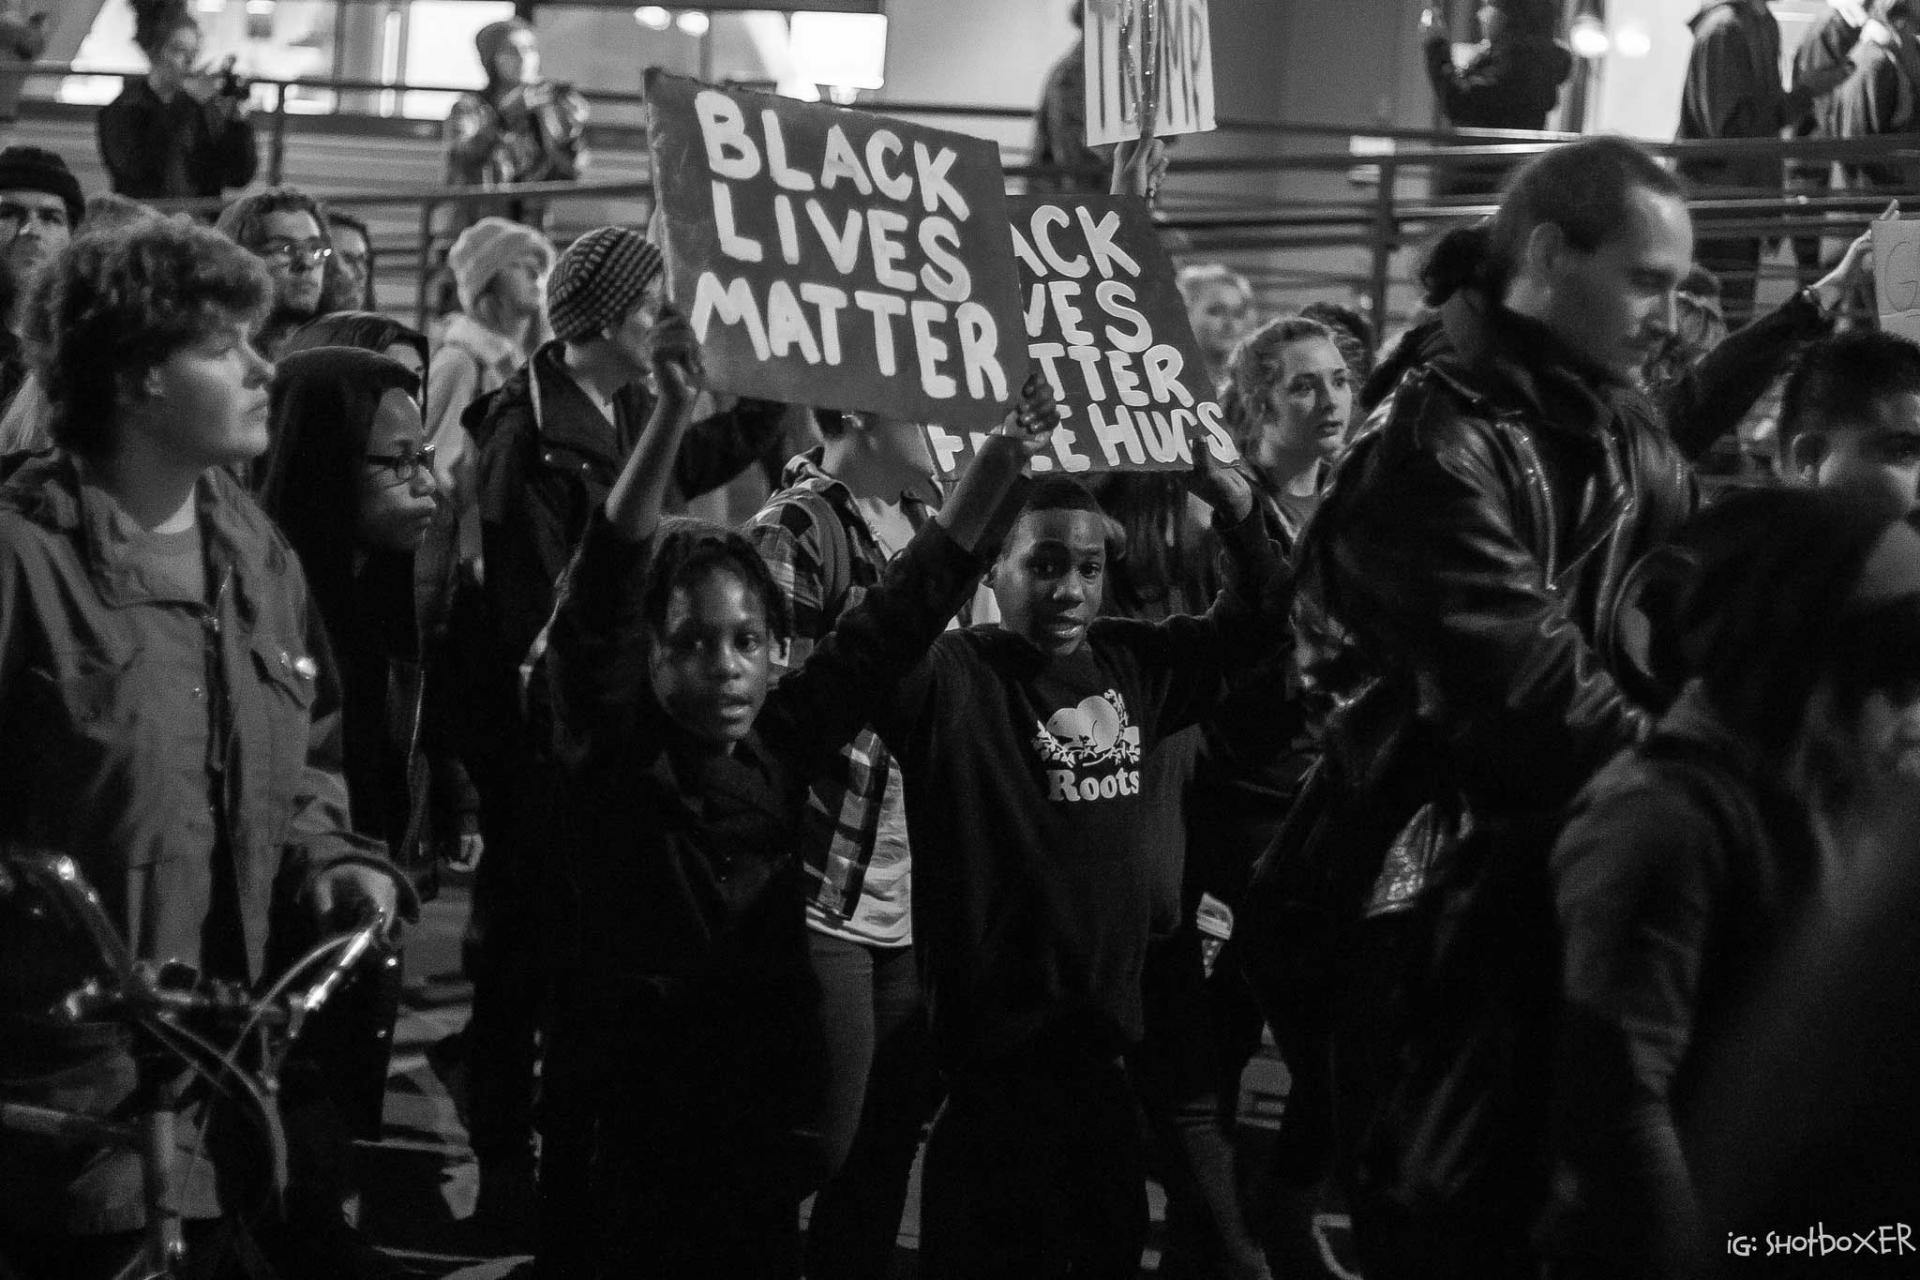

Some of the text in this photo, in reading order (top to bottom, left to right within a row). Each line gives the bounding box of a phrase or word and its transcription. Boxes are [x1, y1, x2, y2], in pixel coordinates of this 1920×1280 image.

[694, 90, 970, 221] BLACK
[711, 179, 971, 302] LIVES
[1010, 205, 1141, 279] ACK
[691, 271, 1008, 402] MATTER
[1023, 280, 1153, 353] VES
[1028, 342, 1194, 407] TTER
[926, 404, 1092, 473] FE
[1046, 767, 1140, 802] Roots
